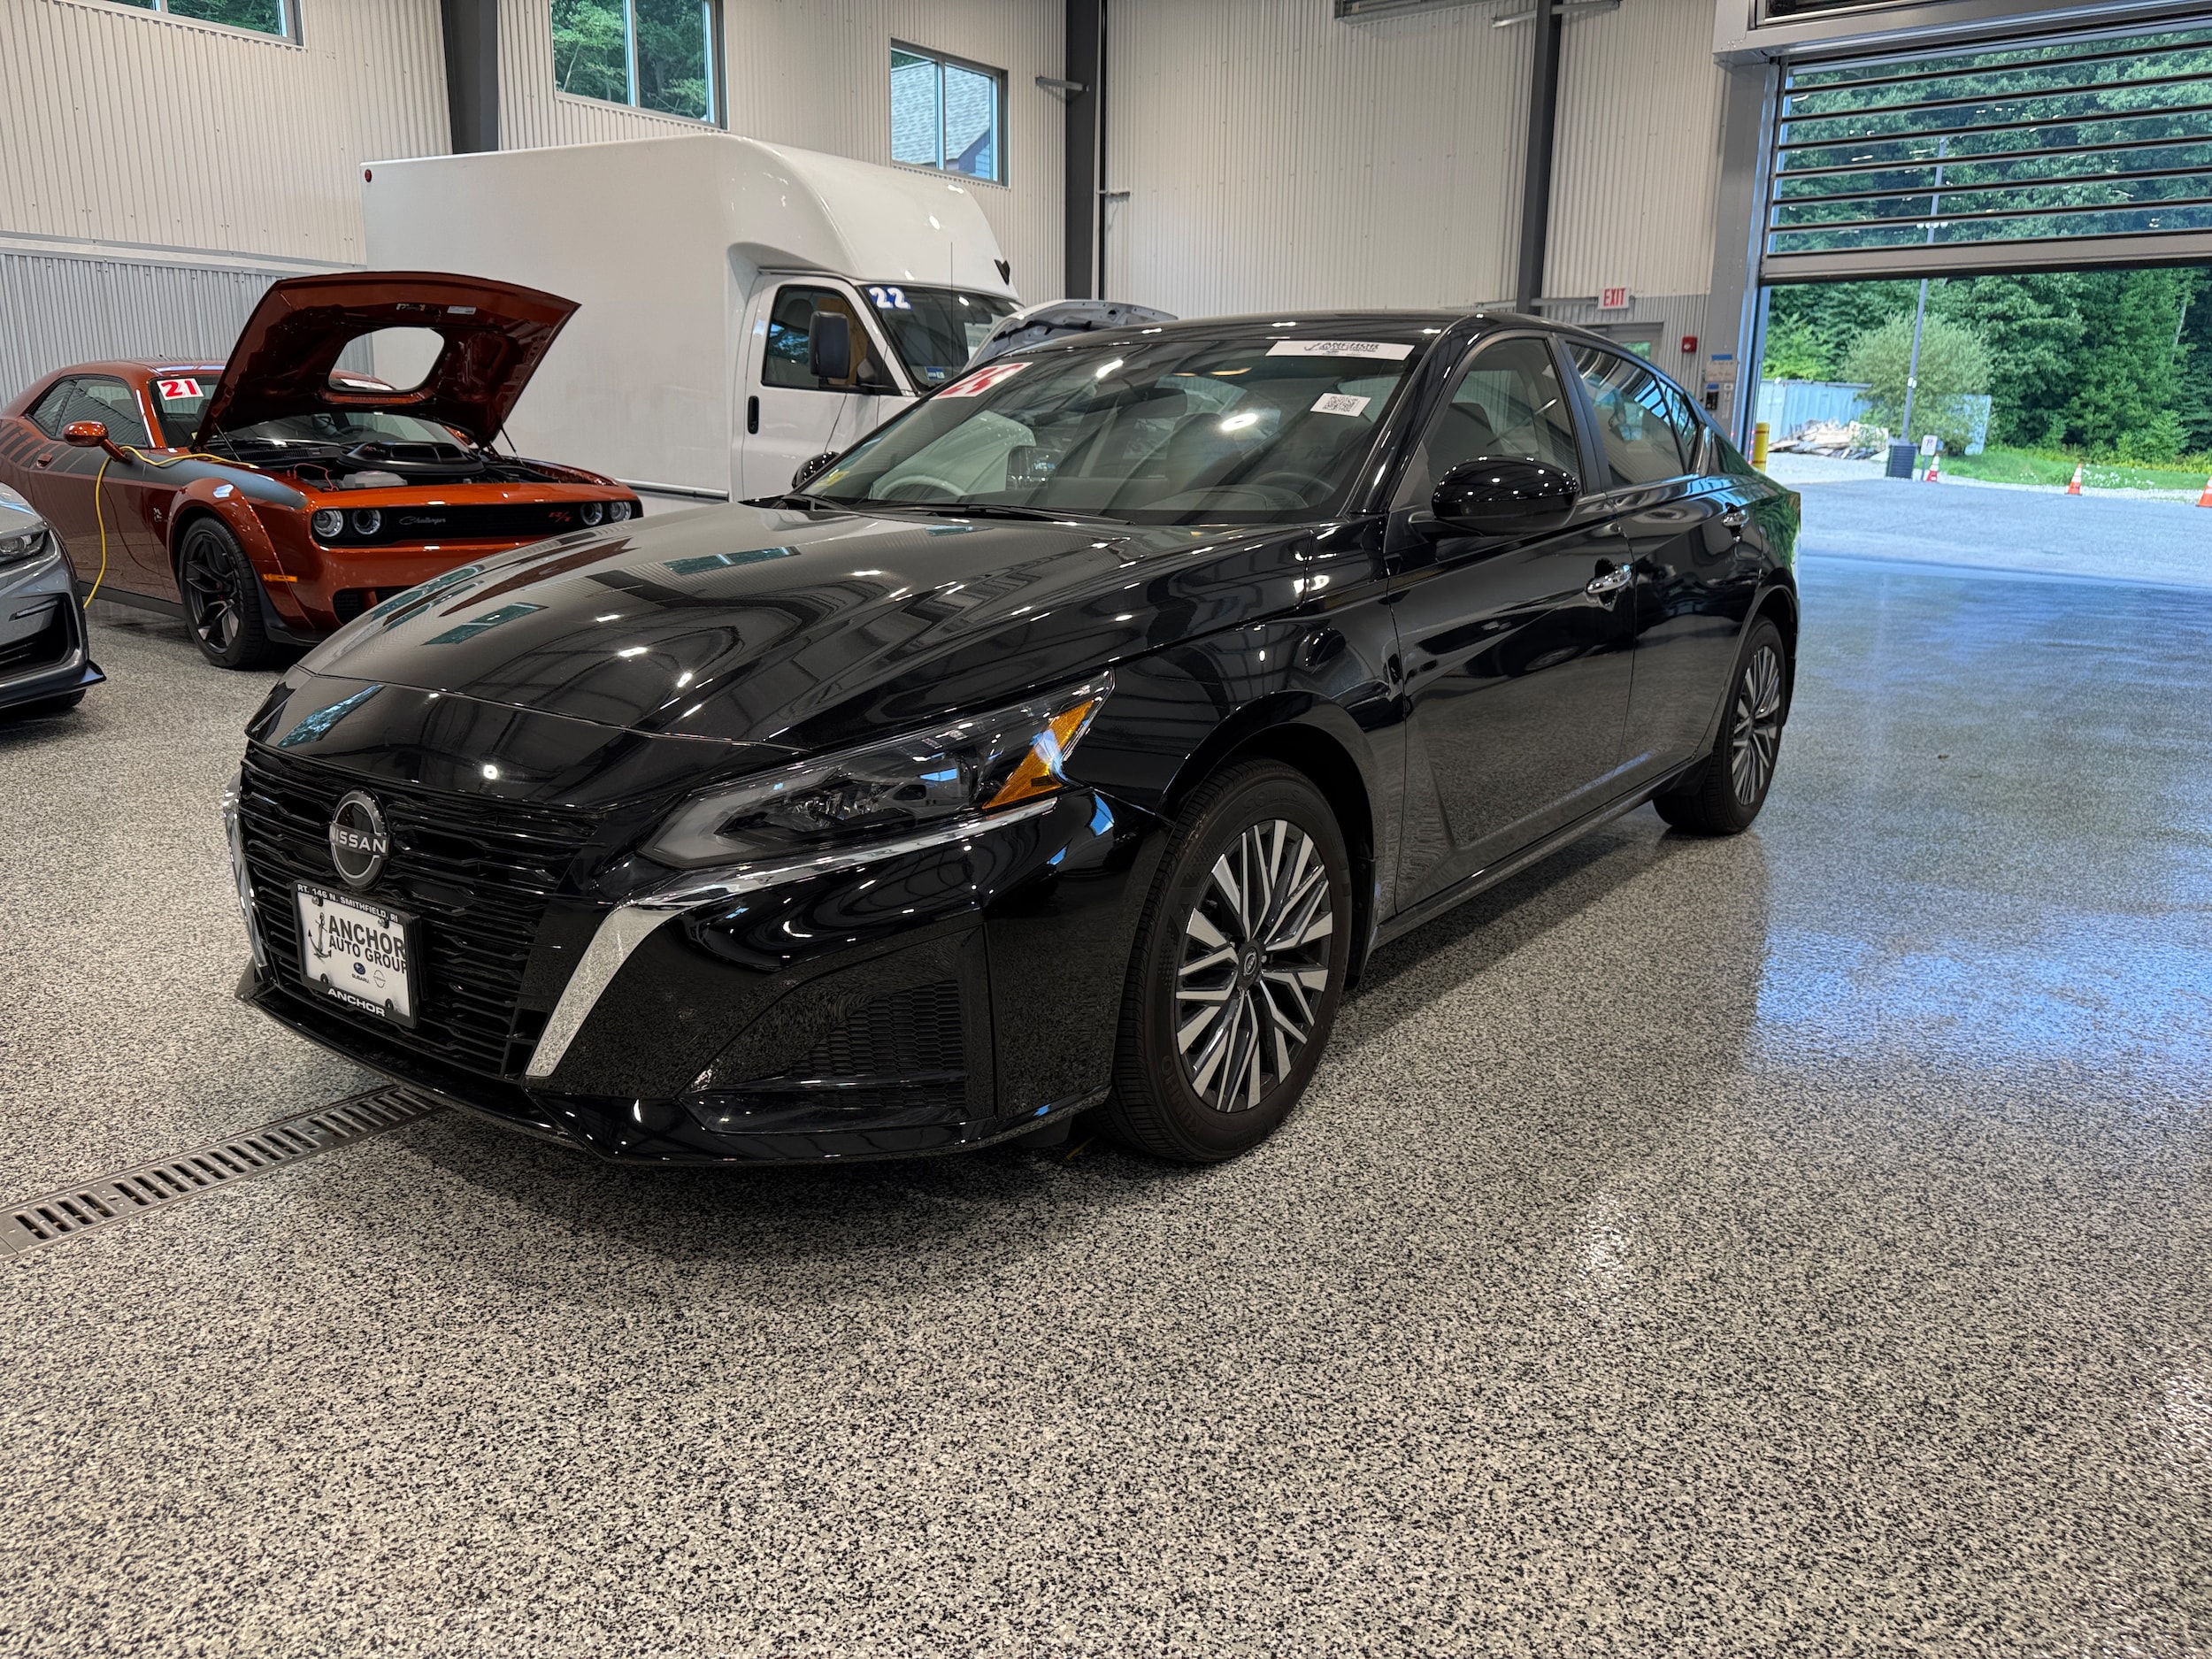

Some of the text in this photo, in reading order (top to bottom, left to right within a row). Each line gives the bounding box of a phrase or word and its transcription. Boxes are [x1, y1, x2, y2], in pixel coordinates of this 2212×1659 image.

[869, 287, 911, 310] 22
[1603, 288, 1625, 307] EXIT
[161, 380, 197, 397] 21
[399, 515, 447, 526] Challenger
[330, 824, 387, 854] NISSAN
[297, 883, 398, 923] RT. 146 N. SMITHFIELD, RI
[328, 915, 405, 960] ANCHOR
[329, 934, 406, 974] AUTO GROUP
[327, 987, 386, 1018] ANCHOR
